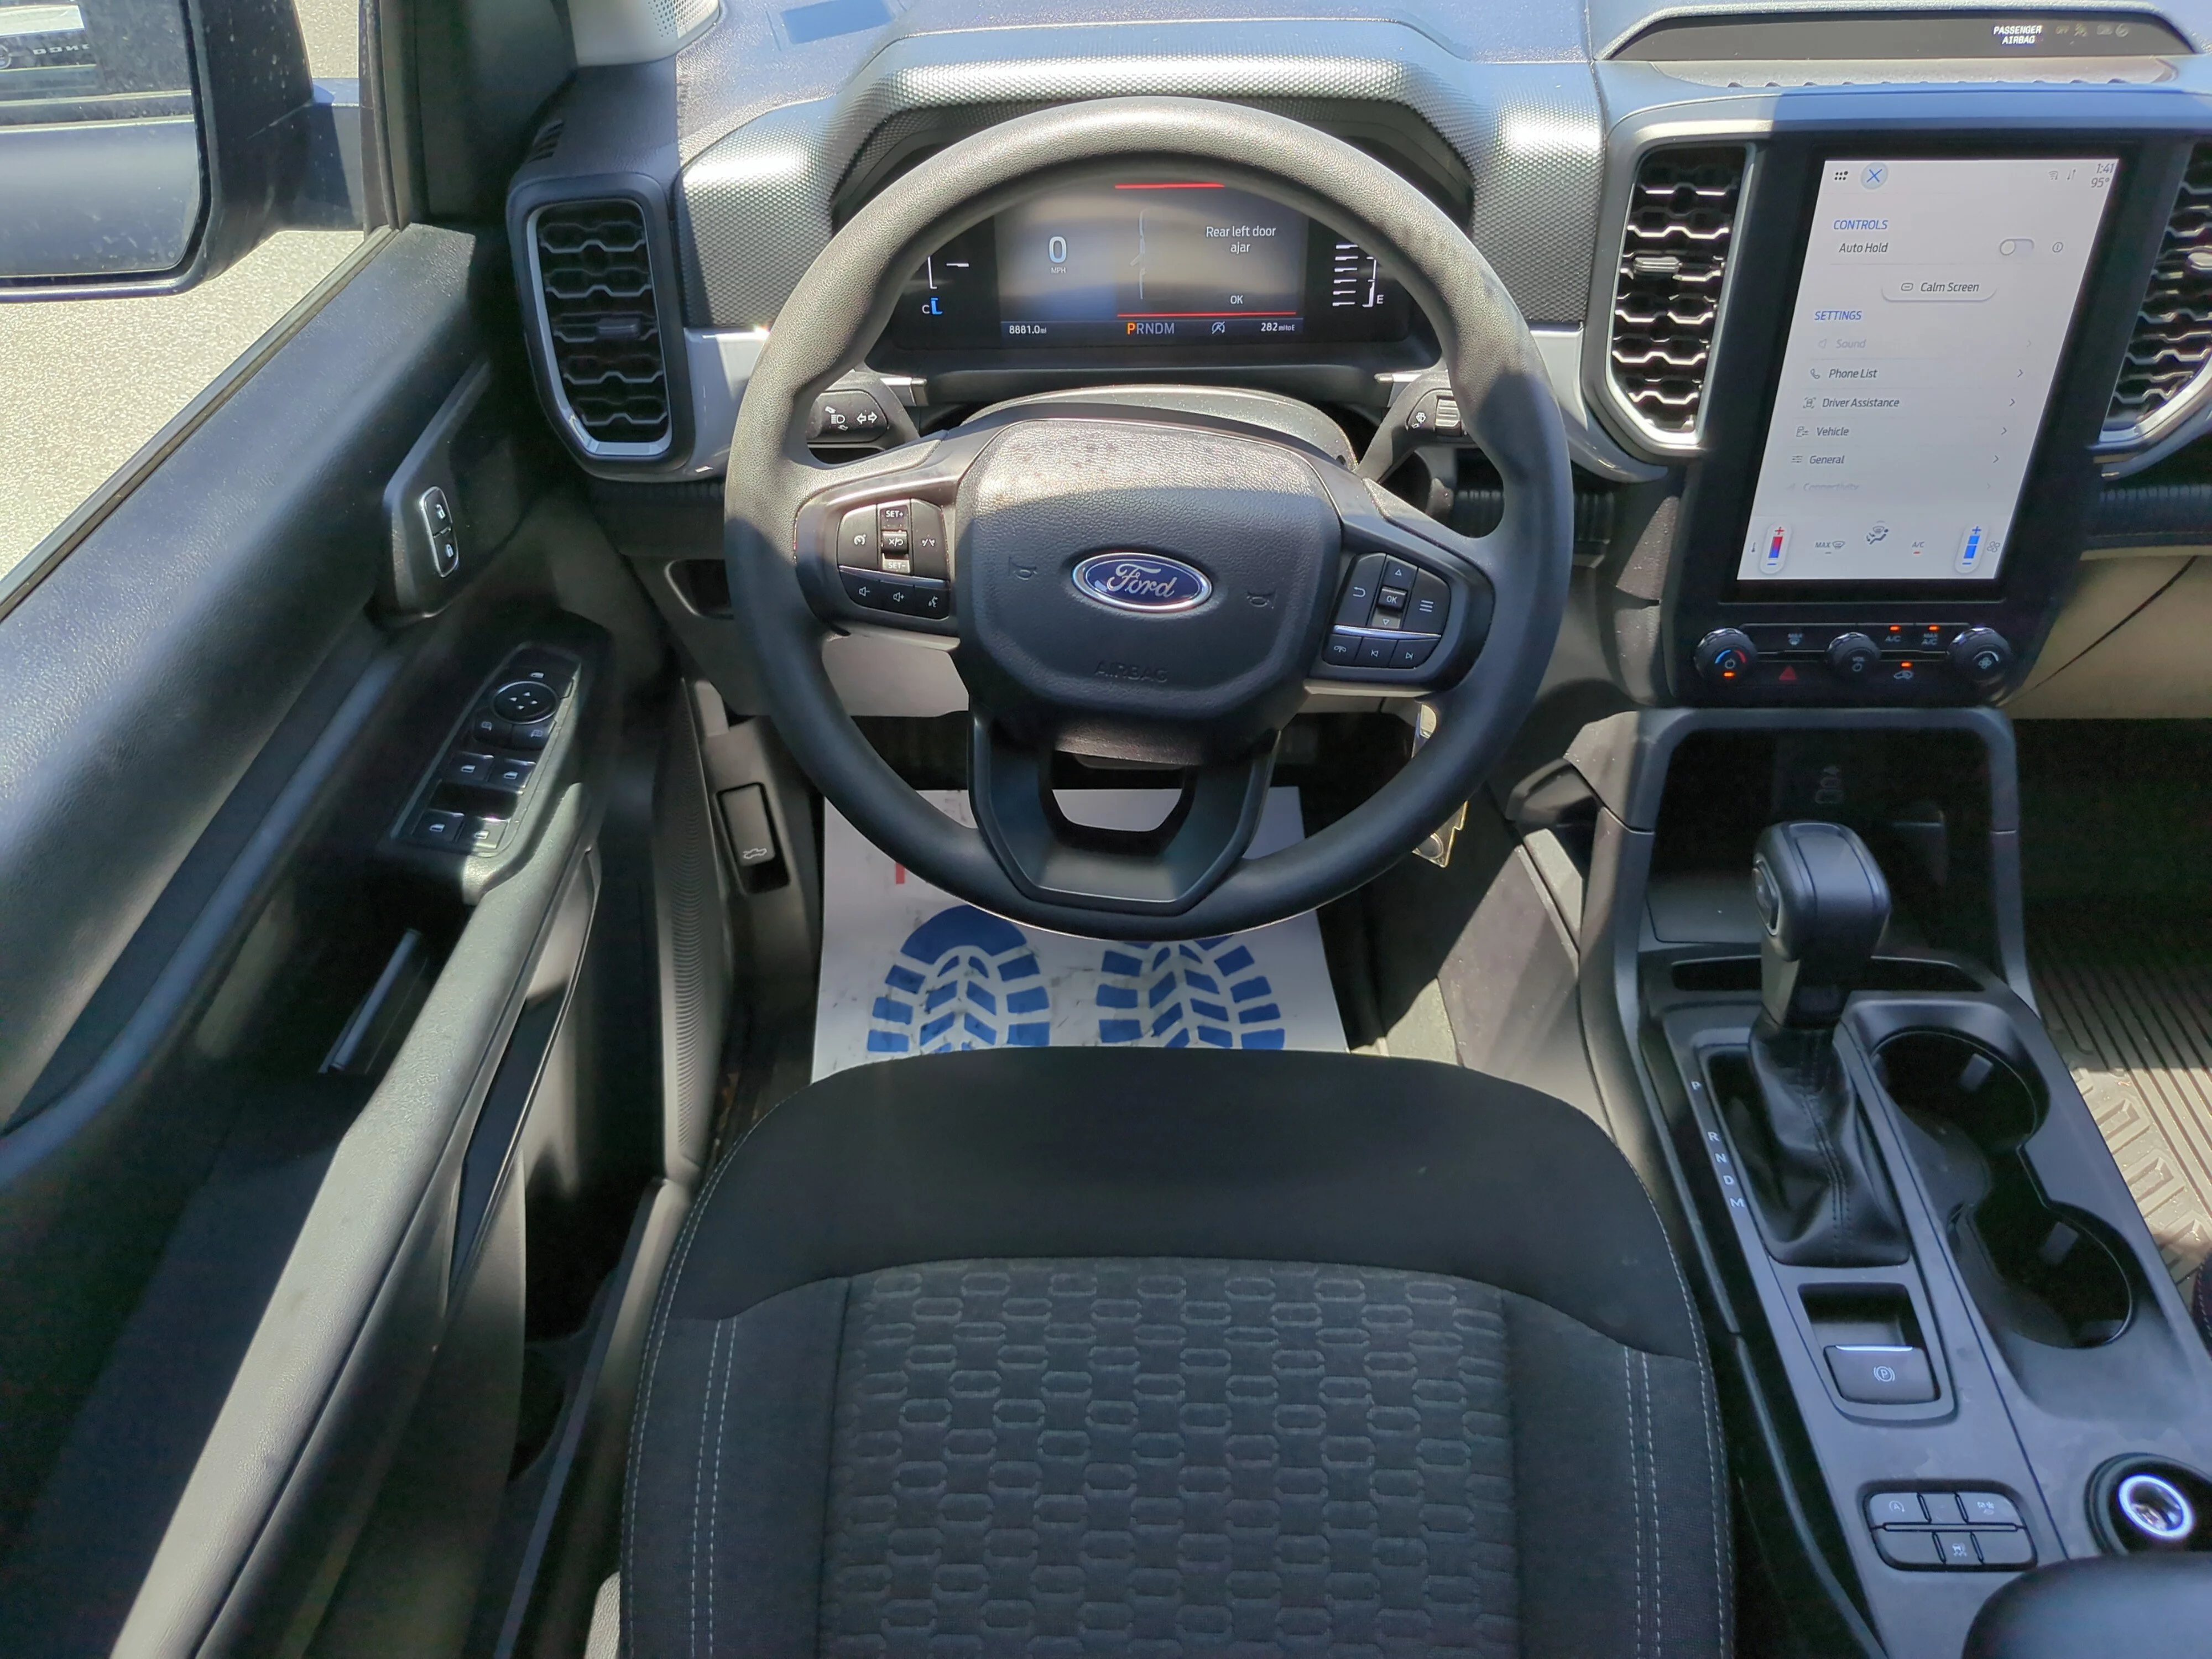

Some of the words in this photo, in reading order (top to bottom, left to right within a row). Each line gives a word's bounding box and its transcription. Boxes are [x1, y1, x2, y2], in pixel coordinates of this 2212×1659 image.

[1993, 25, 2043, 34] PASSENGER
[2002, 35, 2035, 44] AIRBAG
[2096, 163, 2115, 174] 1:41
[1833, 220, 1888, 230] CONTROLS
[1206, 226, 1230, 237] Rear
[1232, 225, 1250, 237] left
[1252, 225, 1276, 237] door
[1049, 236, 1067, 263] 0
[1230, 241, 1250, 254] ajar
[1839, 242, 1863, 253] Auto
[1865, 242, 1888, 253] Hold
[1920, 282, 1945, 292] Calm
[1947, 282, 1979, 292] Screen
[1230, 295, 1244, 305] OK
[1376, 294, 1384, 304] E
[922, 305, 930, 314] C
[1814, 310, 1862, 321] SETTINGS
[1835, 338, 1867, 349] Sound
[1828, 368, 1859, 379] Phone
[1860, 368, 1878, 379] List
[1822, 398, 1850, 408] Driver
[1850, 398, 1900, 408] Assistance
[1817, 426, 1850, 437] Vehicle
[1809, 455, 1845, 465] General
[1107, 563, 1178, 598] Ford
[1386, 595, 1397, 604] OK
[1691, 1081, 1702, 1090] P
[1707, 1131, 1720, 1141] R
[1715, 1153, 1727, 1163] N
[1723, 1175, 1734, 1185] D
[1729, 1198, 1745, 1208] M
